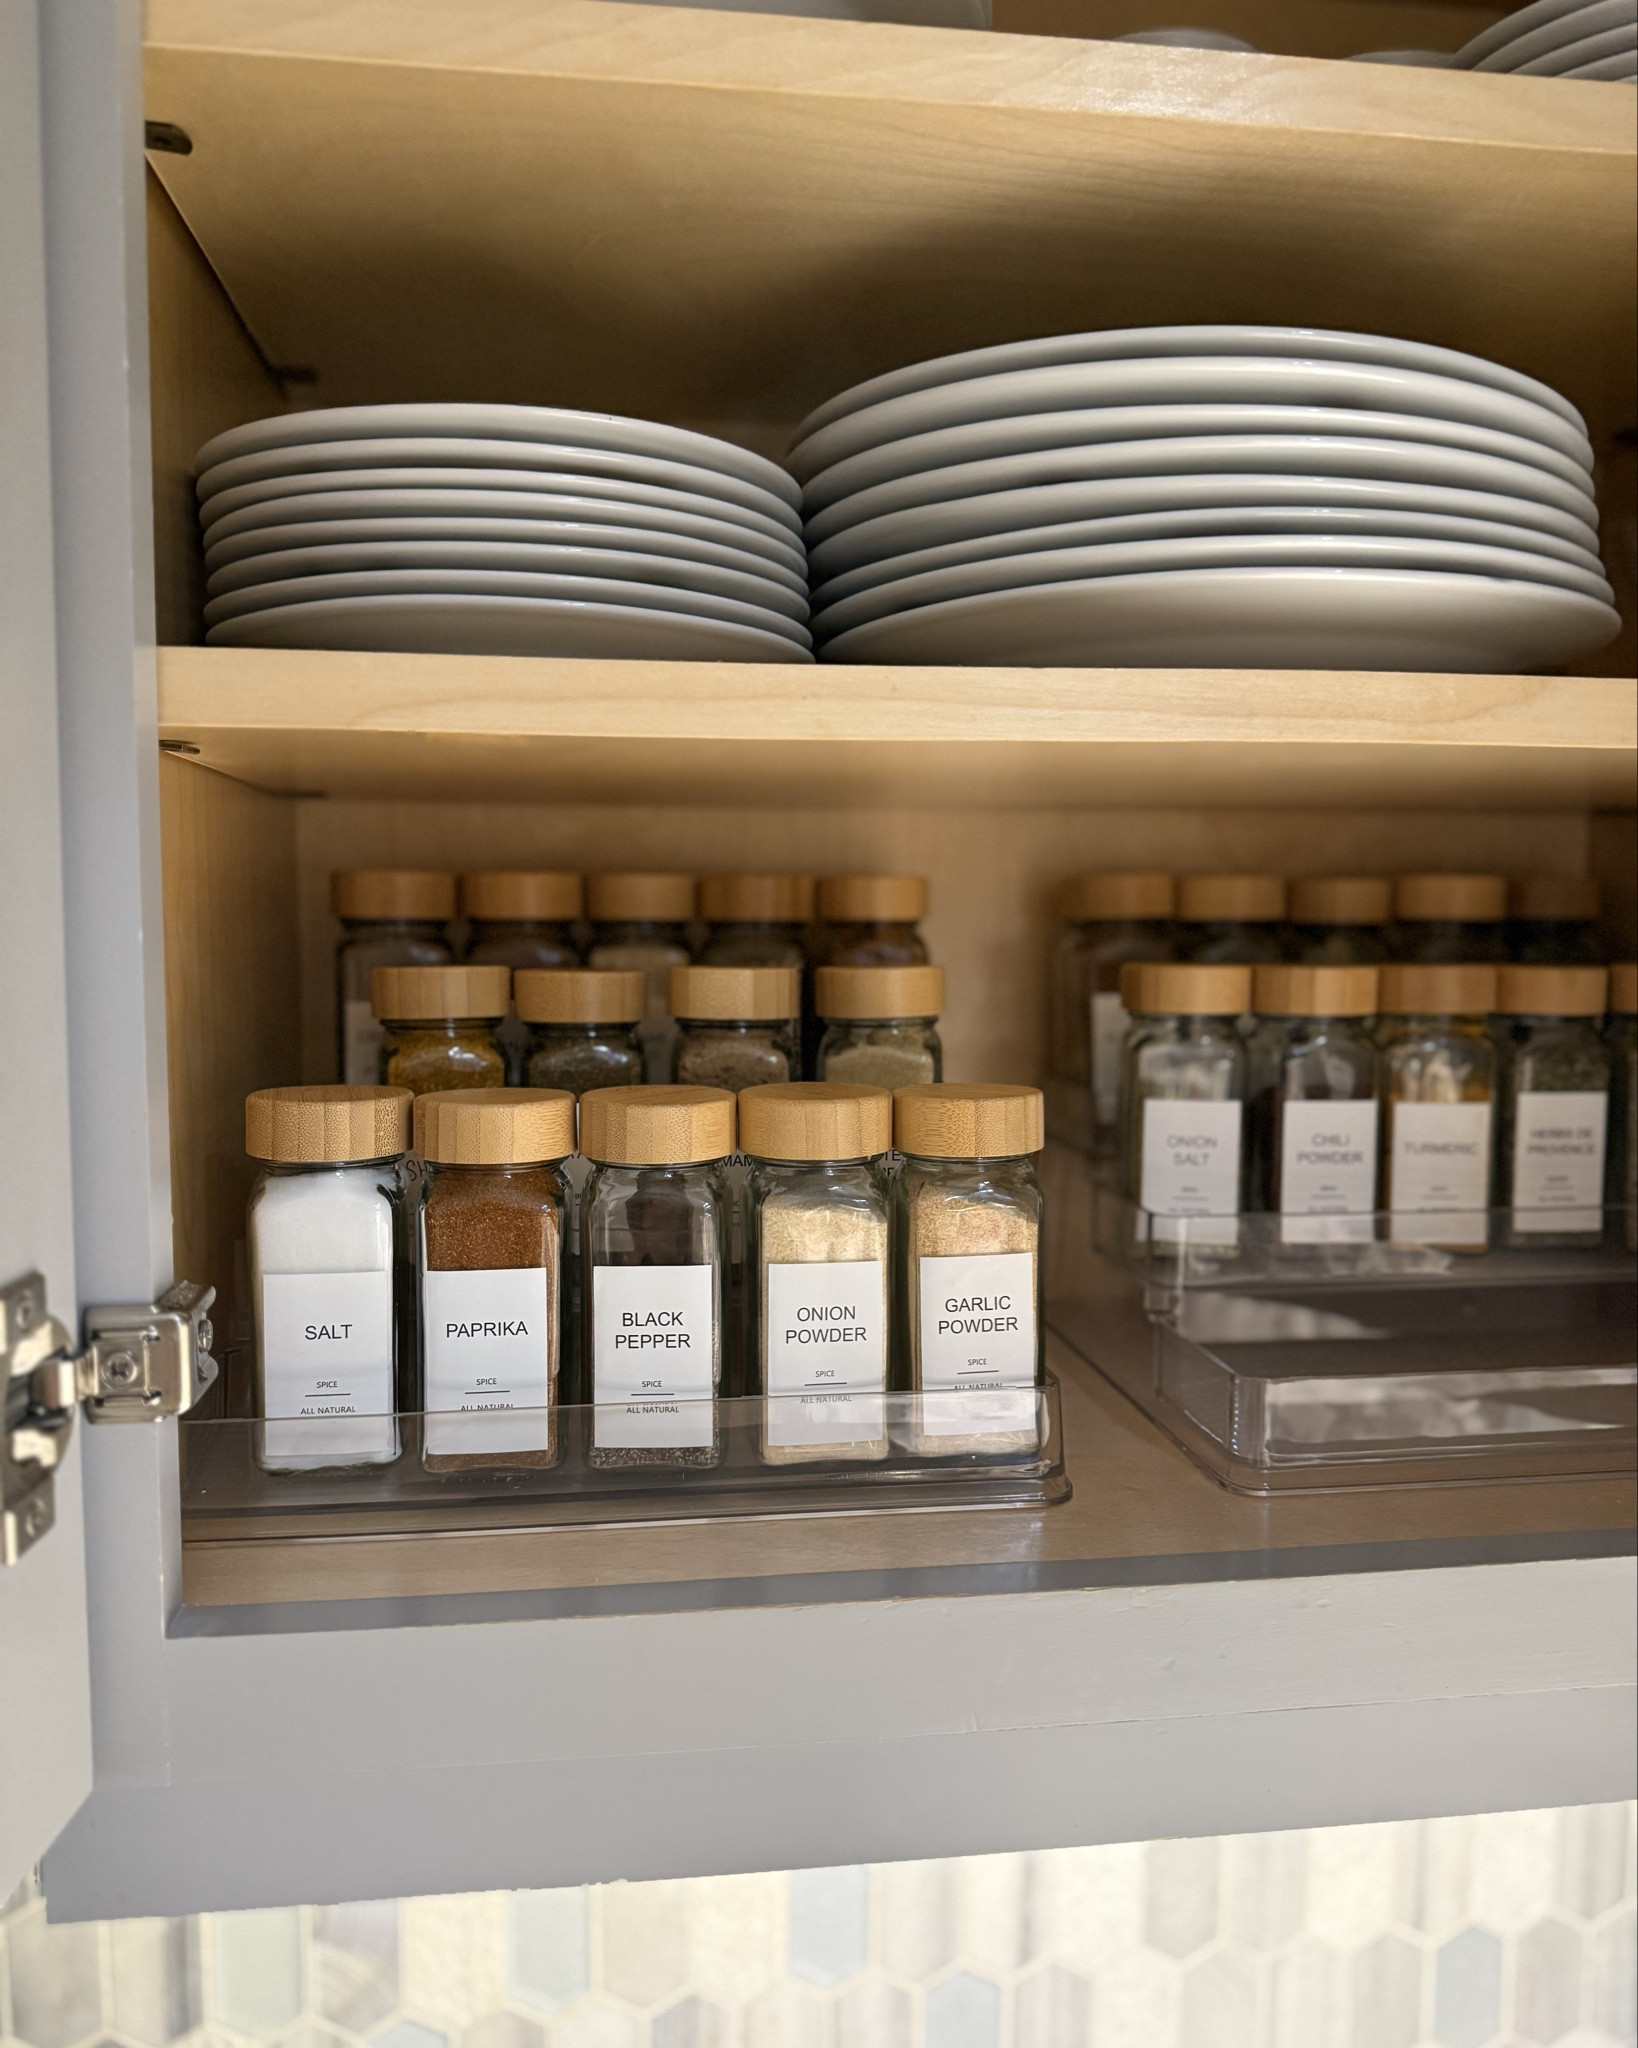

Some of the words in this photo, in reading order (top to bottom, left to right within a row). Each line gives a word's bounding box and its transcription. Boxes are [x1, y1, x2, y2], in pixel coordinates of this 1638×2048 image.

[1165, 1133, 1218, 1149] ONION
[1311, 1132, 1350, 1148] CHILI
[1404, 1141, 1479, 1156] TURMERIC
[1173, 1151, 1210, 1167] SALT
[1296, 1149, 1363, 1166] POWDER
[945, 1295, 1012, 1313] GARLIC
[622, 1311, 684, 1328] BLACK
[796, 1305, 857, 1322] ONION
[304, 1323, 353, 1340] SALT
[446, 1320, 529, 1338] PAPRIKA
[938, 1316, 1019, 1335] POWDER
[615, 1333, 691, 1349] PEPPER
[785, 1326, 868, 1344] POWDER
[967, 1358, 988, 1366] SPICE
[476, 1377, 498, 1386] SPICE
[815, 1369, 836, 1378] SPICE
[316, 1380, 338, 1389] SPICE
[641, 1380, 663, 1388] SPICE
[800, 1396, 815, 1404] ALL
[816, 1395, 852, 1404] NATURAL
[300, 1407, 316, 1415] ALL
[317, 1405, 356, 1415] NATURAL
[626, 1406, 641, 1414] ALL
[642, 1405, 680, 1414] NATURAL
